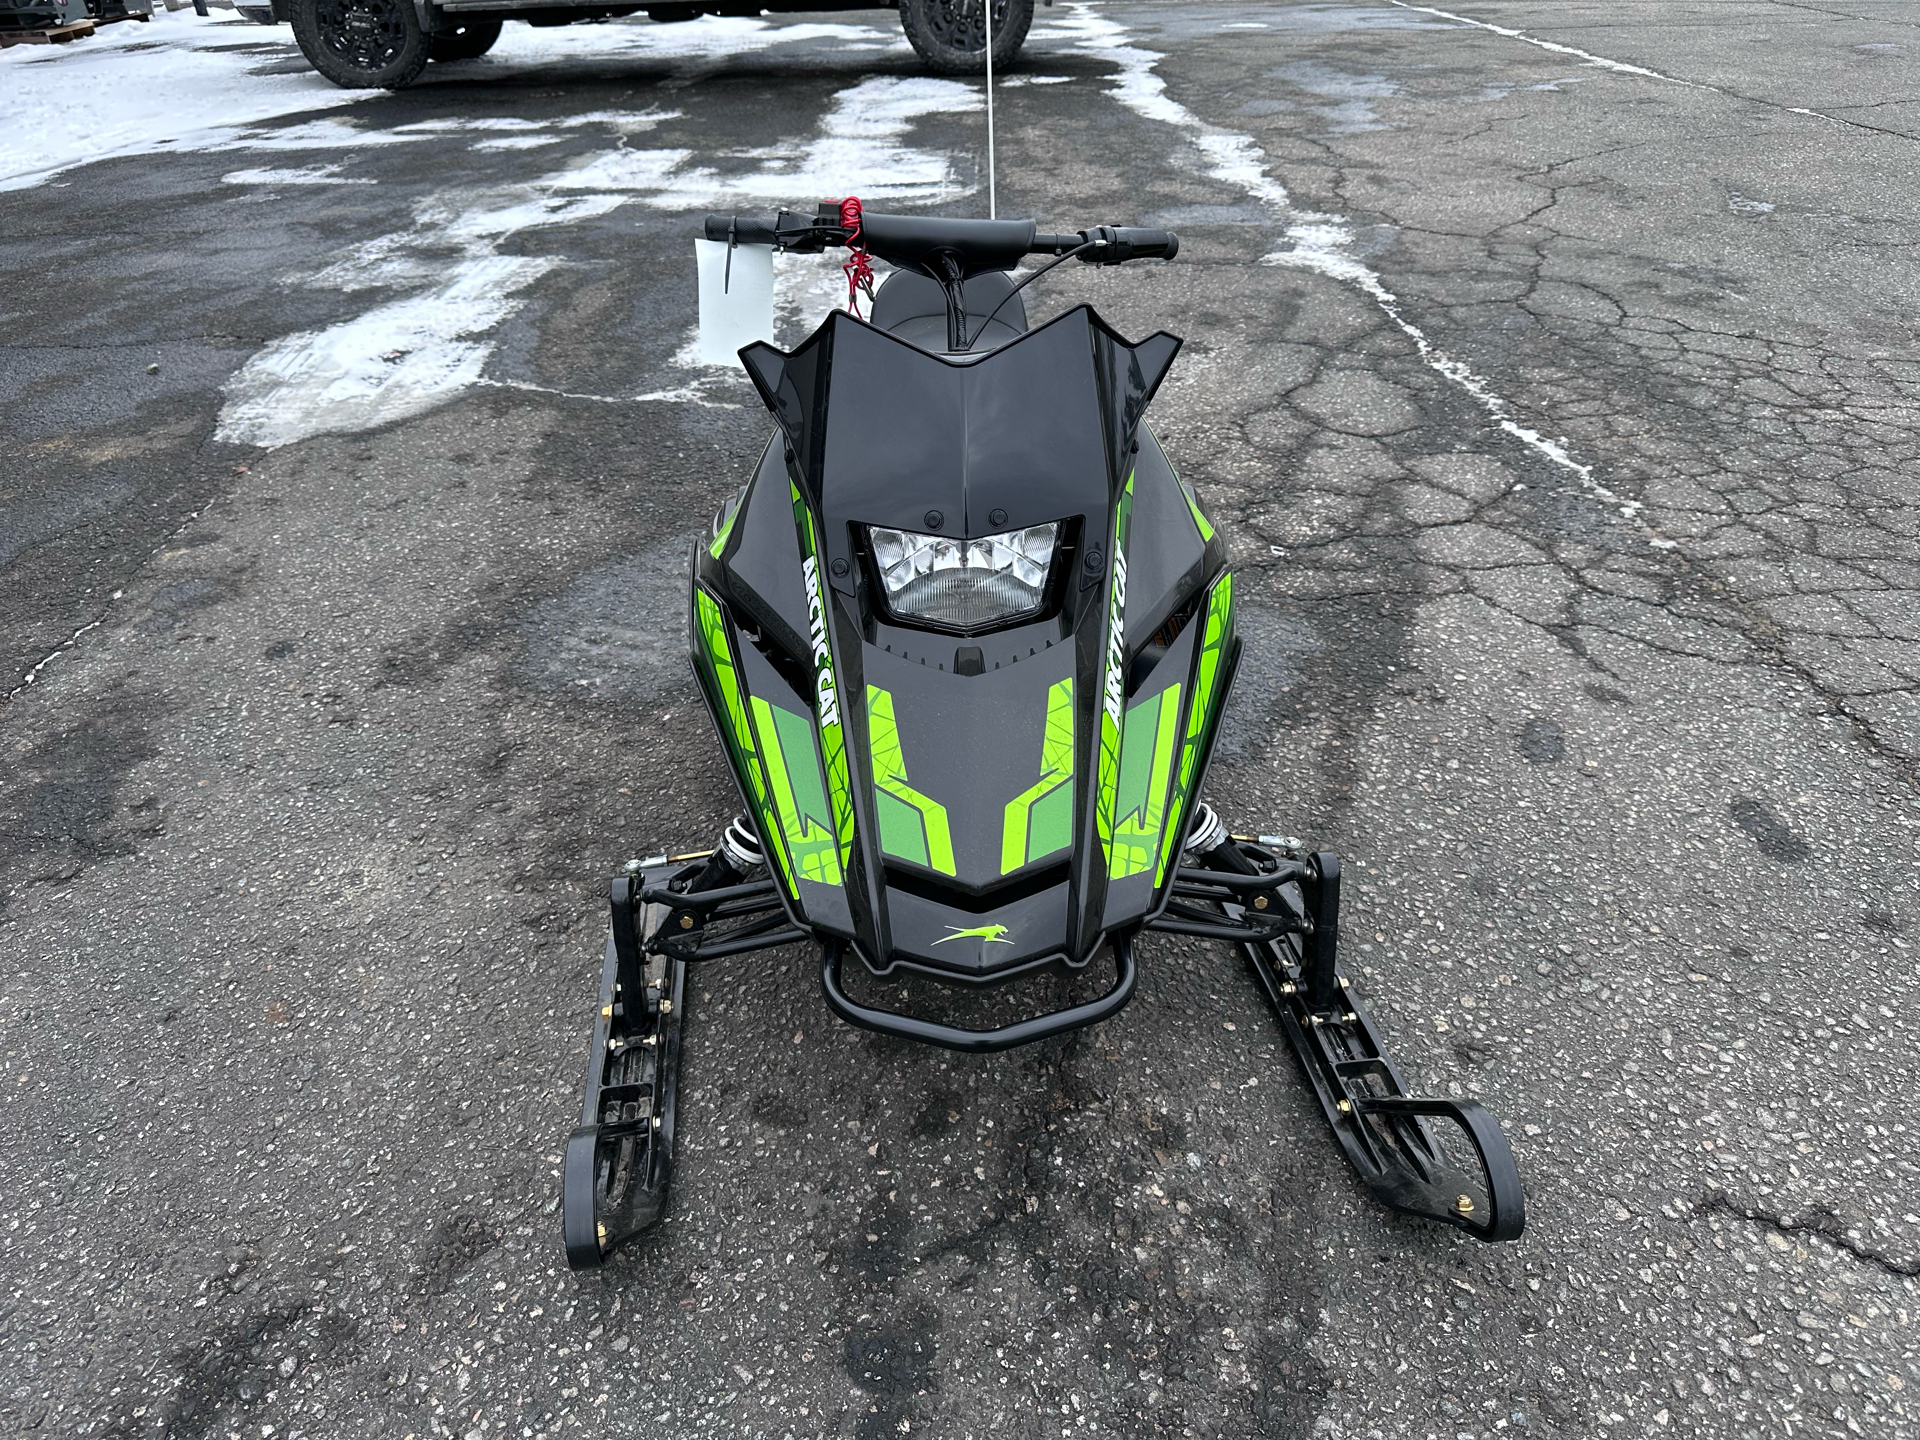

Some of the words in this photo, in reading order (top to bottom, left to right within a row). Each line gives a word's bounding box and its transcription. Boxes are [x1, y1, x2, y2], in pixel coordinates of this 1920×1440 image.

[1113, 538, 1127, 608] CAT
[802, 555, 829, 668] ARCTIC
[817, 667, 840, 728] CAT
[1105, 599, 1125, 732] ARCTIC
